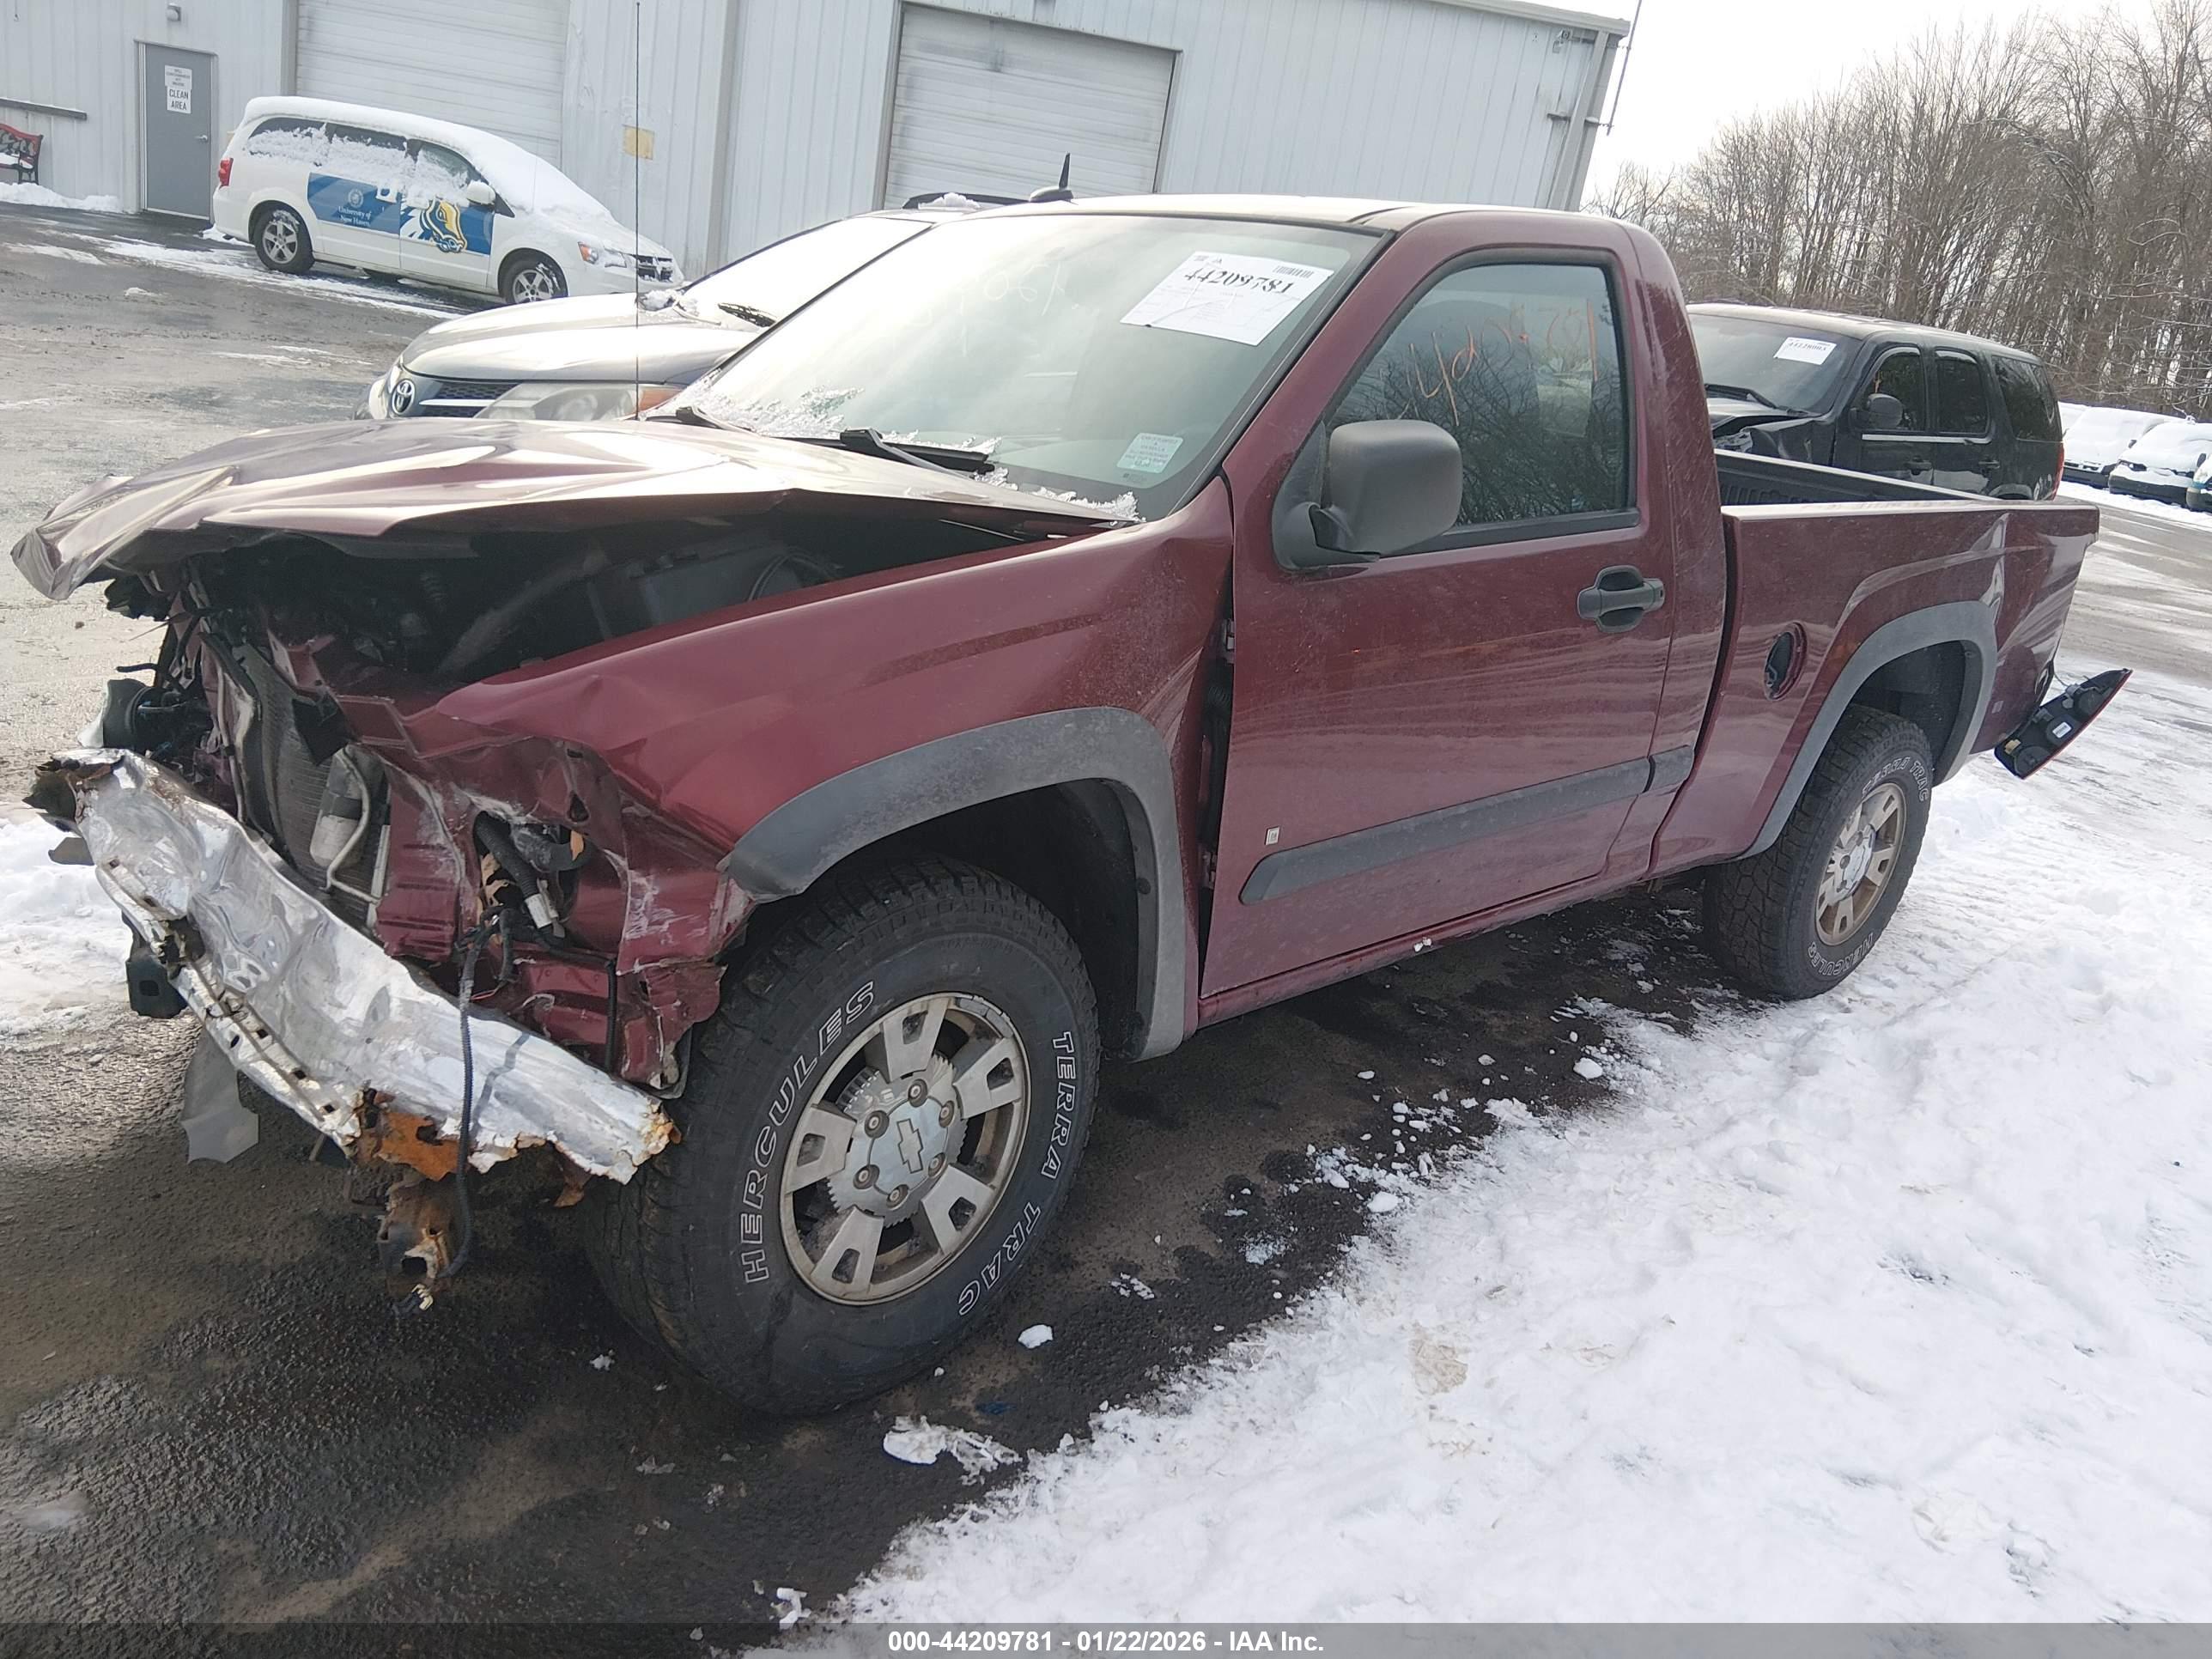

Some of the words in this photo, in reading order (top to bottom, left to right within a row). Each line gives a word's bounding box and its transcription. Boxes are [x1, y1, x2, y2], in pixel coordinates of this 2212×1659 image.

[169, 88, 189, 100] CLEAN
[171, 100, 187, 110] AREA
[338, 205, 365, 219] University
[1184, 267, 1294, 295] 44209781
[1910, 760, 1930, 802] TRAC
[1808, 933, 1875, 976] HERCULES
[1042, 1031, 1076, 1180] TERRA
[740, 981, 875, 1283] HERCULES
[957, 1201, 1041, 1316] TRAC
